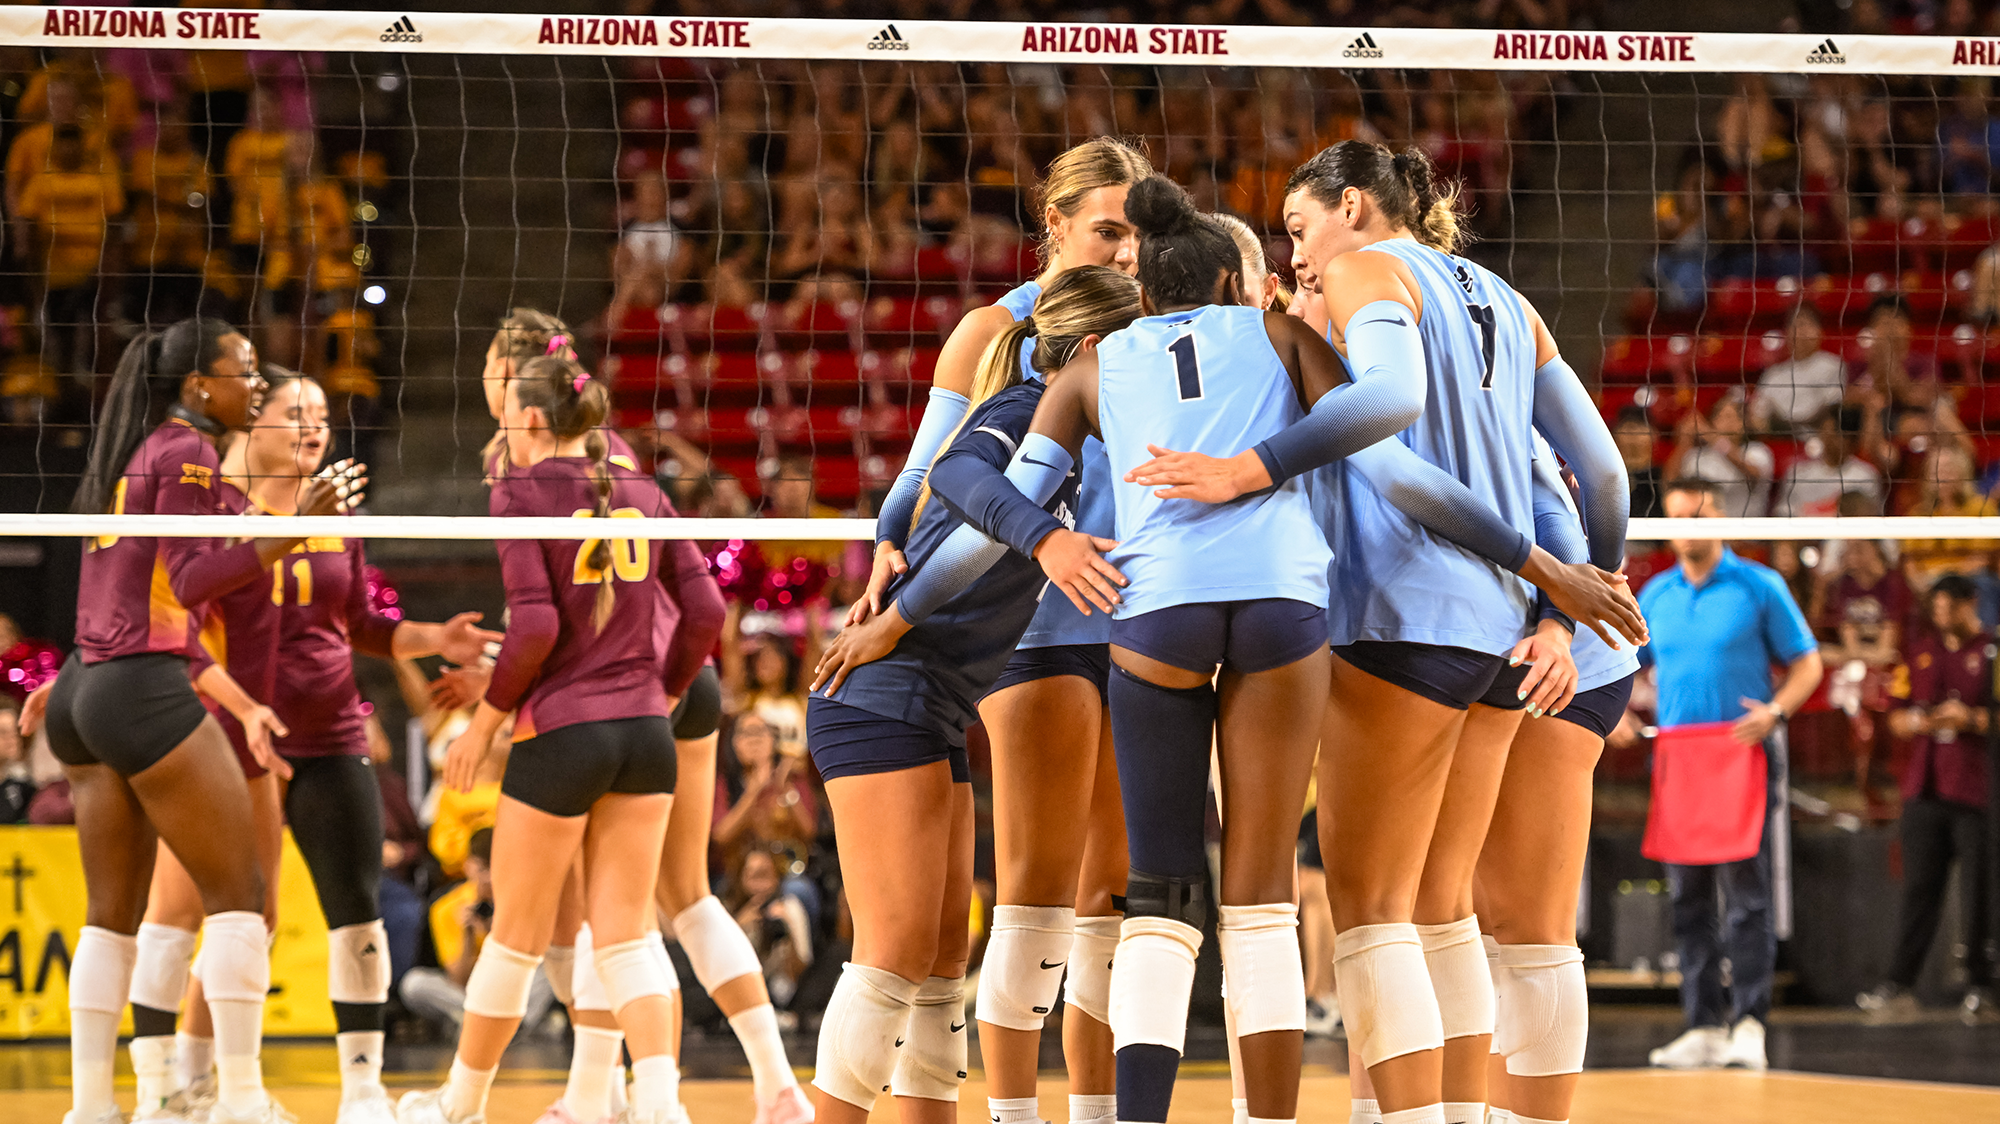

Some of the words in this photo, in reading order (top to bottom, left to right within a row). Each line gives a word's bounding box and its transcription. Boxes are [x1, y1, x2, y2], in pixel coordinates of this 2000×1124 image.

[42, 9, 166, 38] ARIZONA
[176, 11, 261, 40] STATE
[380, 31, 423, 43] adidas
[538, 18, 658, 46] ARIZONA
[668, 20, 750, 48] STATE
[867, 39, 909, 51] adidas
[1022, 26, 1138, 54] ARIZONA
[1149, 28, 1228, 55] STATE
[1342, 47, 1383, 58] adidas
[1494, 33, 1608, 61] ARIZONA
[1617, 35, 1695, 62] STATE
[1952, 40, 2000, 66] ARI
[1806, 54, 1846, 65] adidas
[1465, 302, 1498, 391] 7
[1165, 330, 1205, 403] 1
[571, 506, 650, 585] 20
